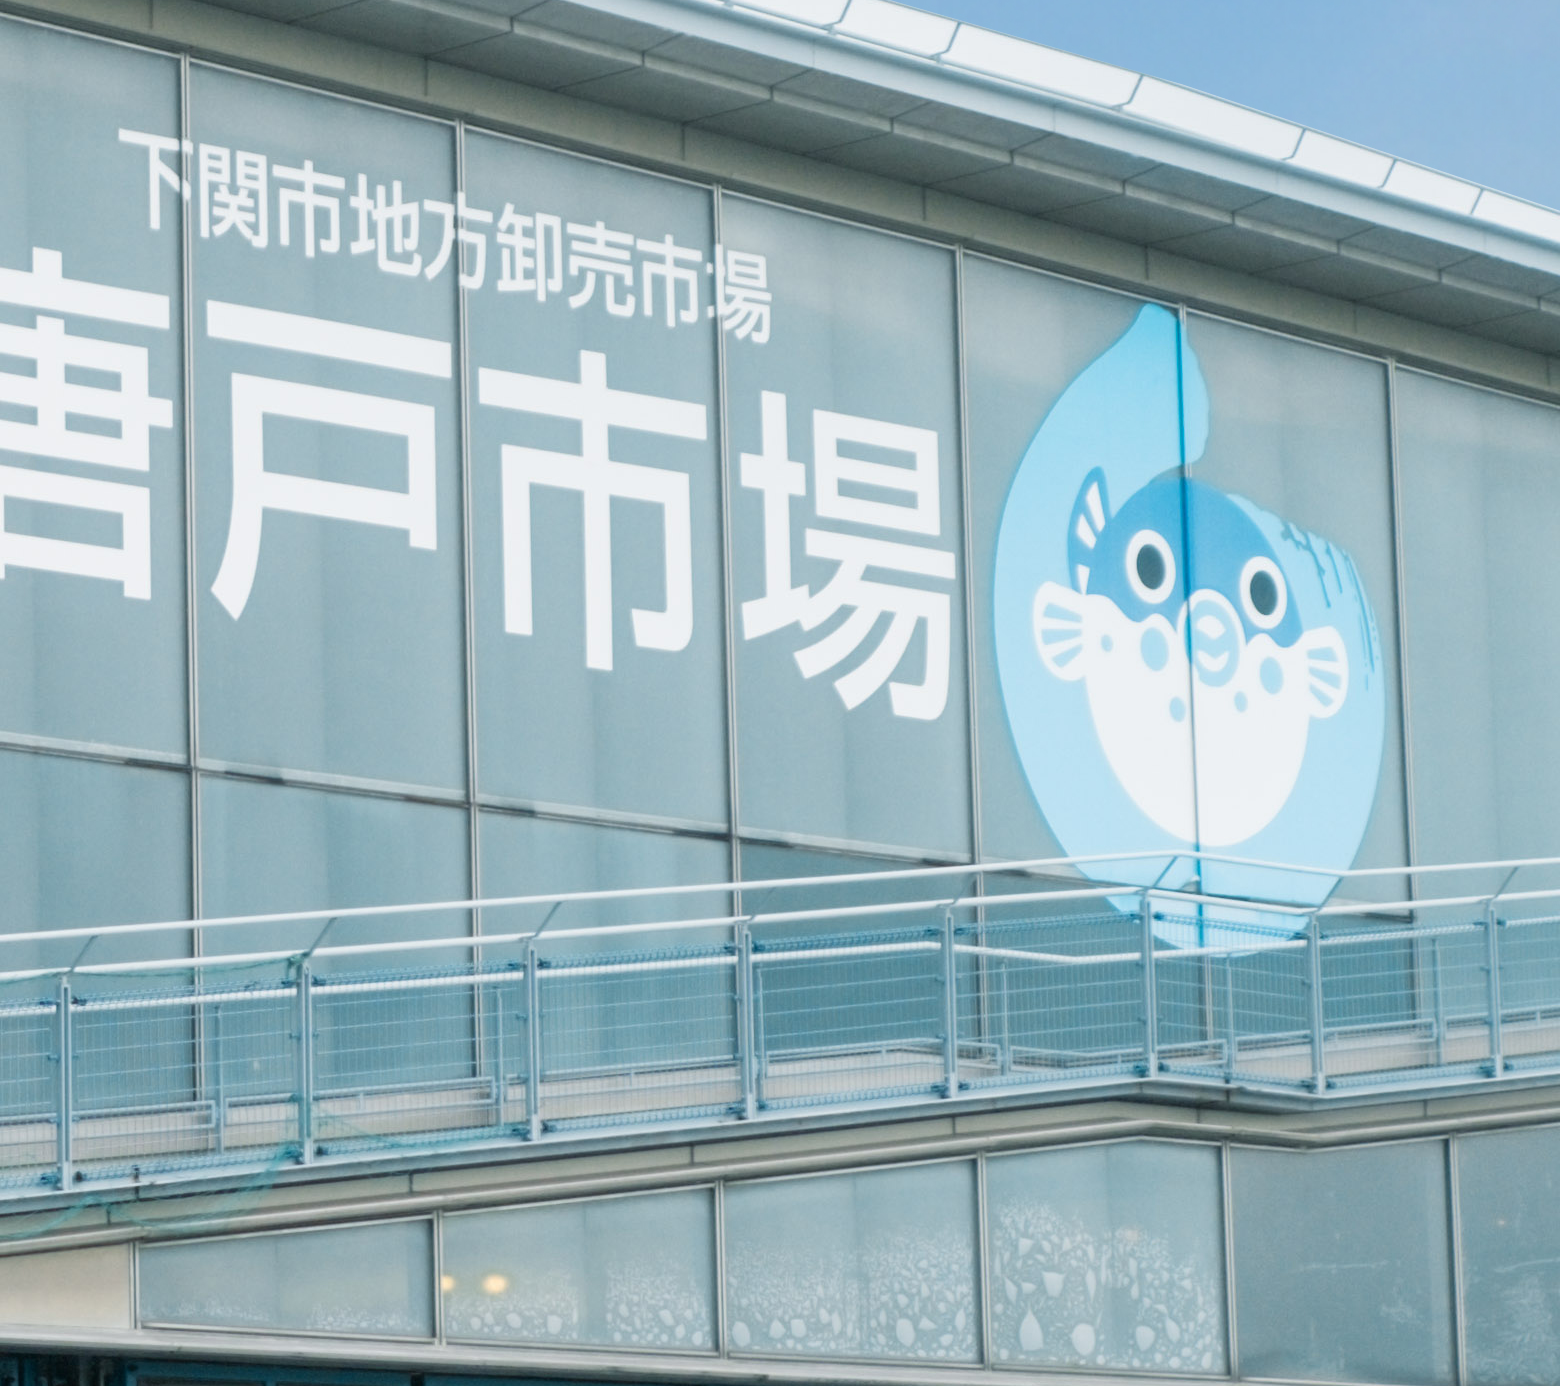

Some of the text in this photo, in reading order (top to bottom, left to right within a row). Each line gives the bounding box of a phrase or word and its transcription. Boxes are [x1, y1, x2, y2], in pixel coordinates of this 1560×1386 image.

[117, 126, 773, 346] 下関市地方卸売市場
